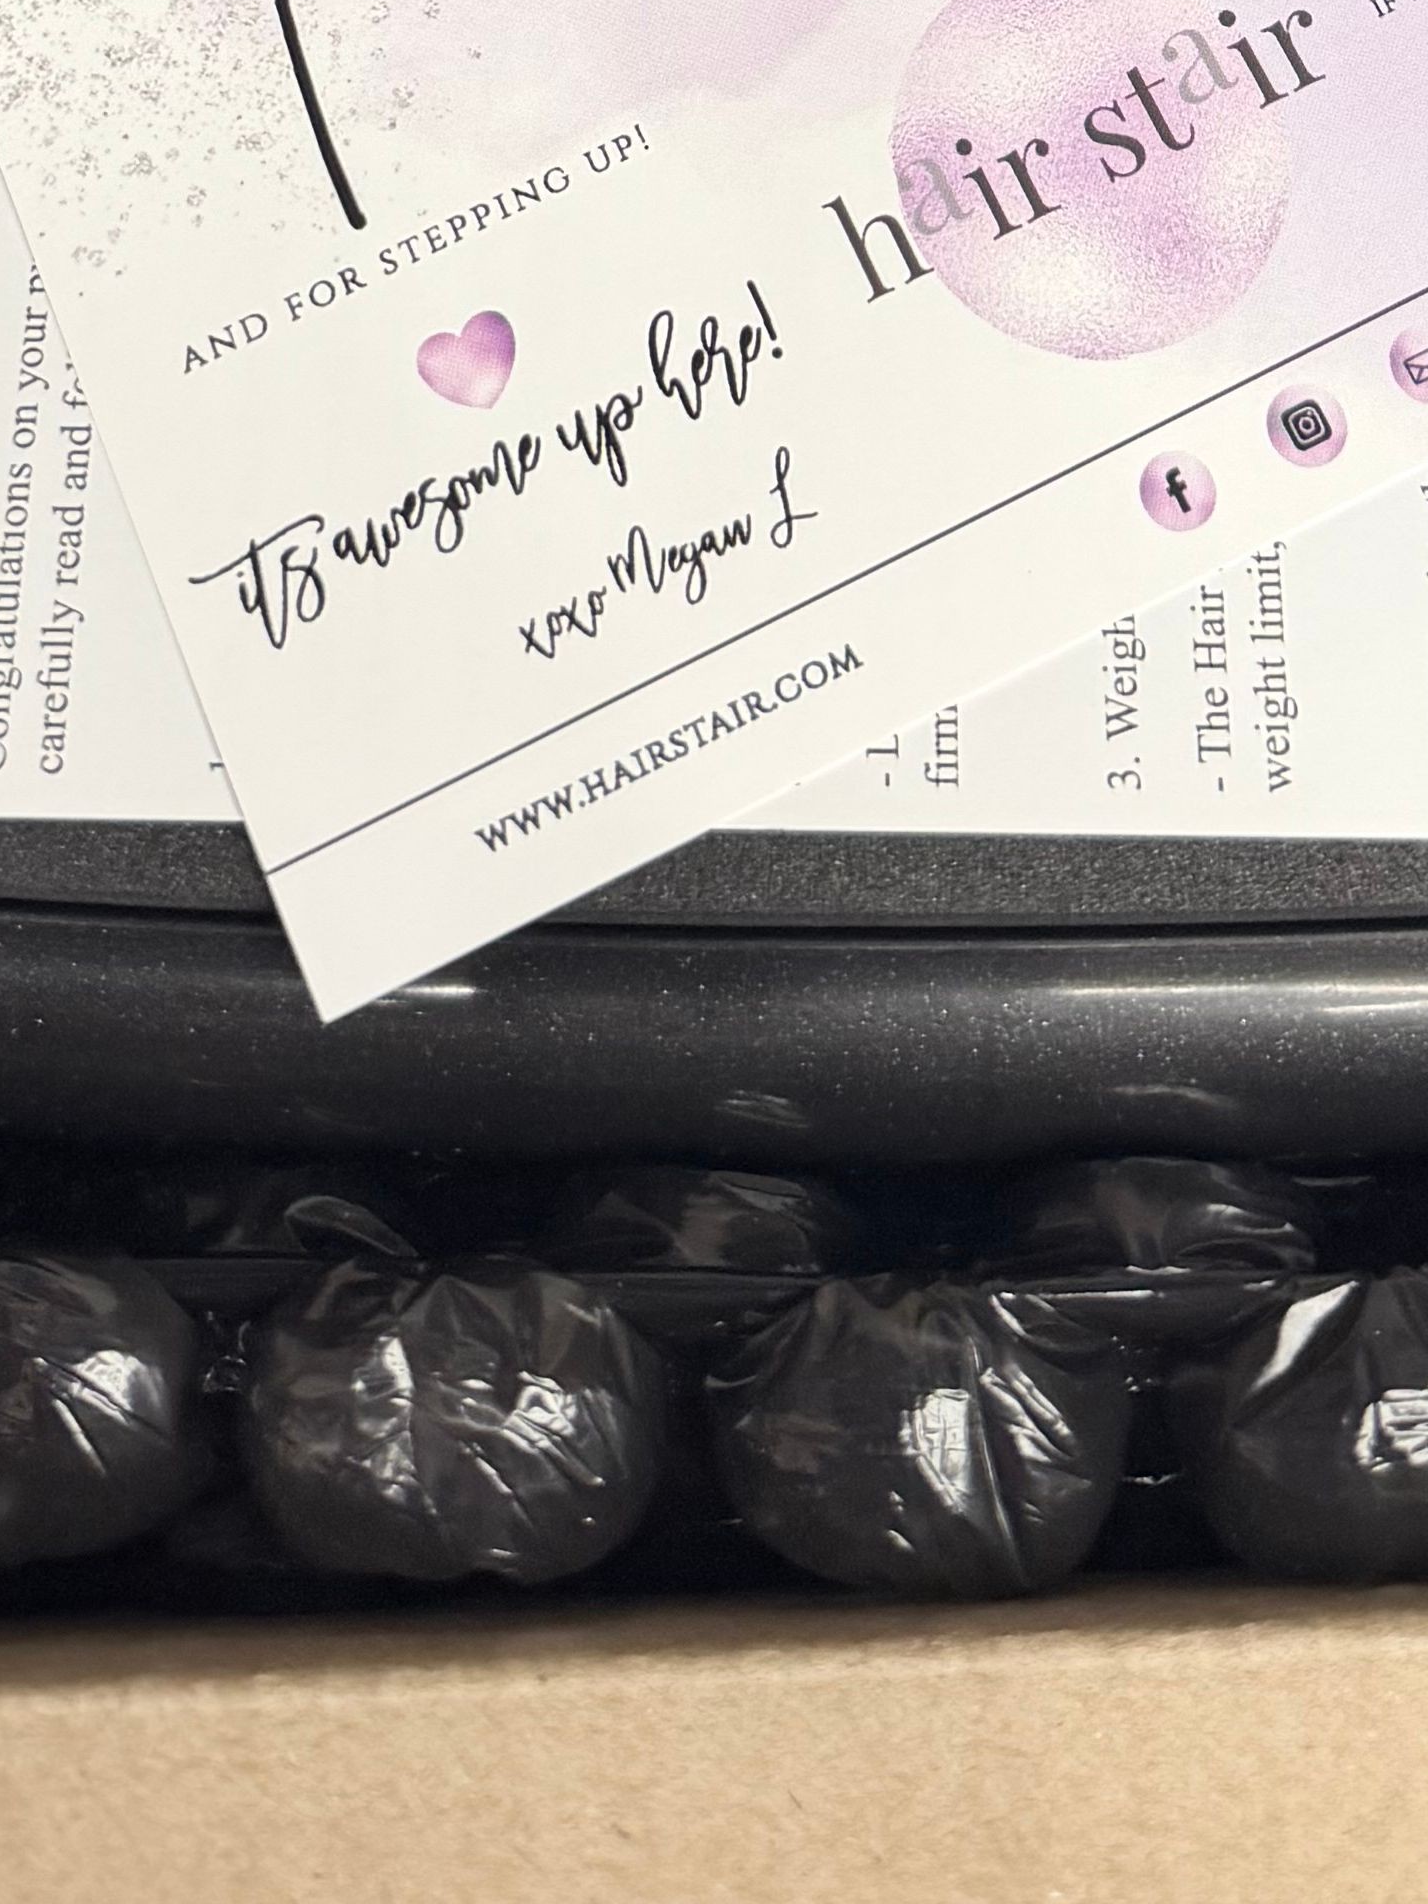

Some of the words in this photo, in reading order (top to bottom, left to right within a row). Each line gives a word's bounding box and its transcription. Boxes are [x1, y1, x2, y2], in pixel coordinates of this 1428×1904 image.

[821, 137, 1062, 303] hair
[1082, 8, 1327, 184] stair
[181, 311, 270, 374] AND
[283, 266, 368, 323] FOR
[377, 164, 573, 279] STEPPING
[584, 123, 652, 176] UP!
[17, 305, 50, 391] your
[12, 403, 39, 450] on
[59, 423, 93, 491] and
[332, 433, 542, 567] awesome
[555, 385, 644, 487] up
[647, 279, 785, 420] here!
[51, 503, 85, 587] read
[518, 586, 607, 660] xoxo
[606, 525, 752, 605] Megan
[769, 446, 820, 549] L
[1246, 540, 1287, 643] limit,
[1189, 584, 1228, 673] Hair
[35, 599, 85, 775] carefully
[1195, 687, 1232, 764] The
[1252, 656, 1299, 793] weight
[473, 643, 865, 854] WWW.HAIRSTAIR.COM
[1106, 756, 1142, 791] 3.
